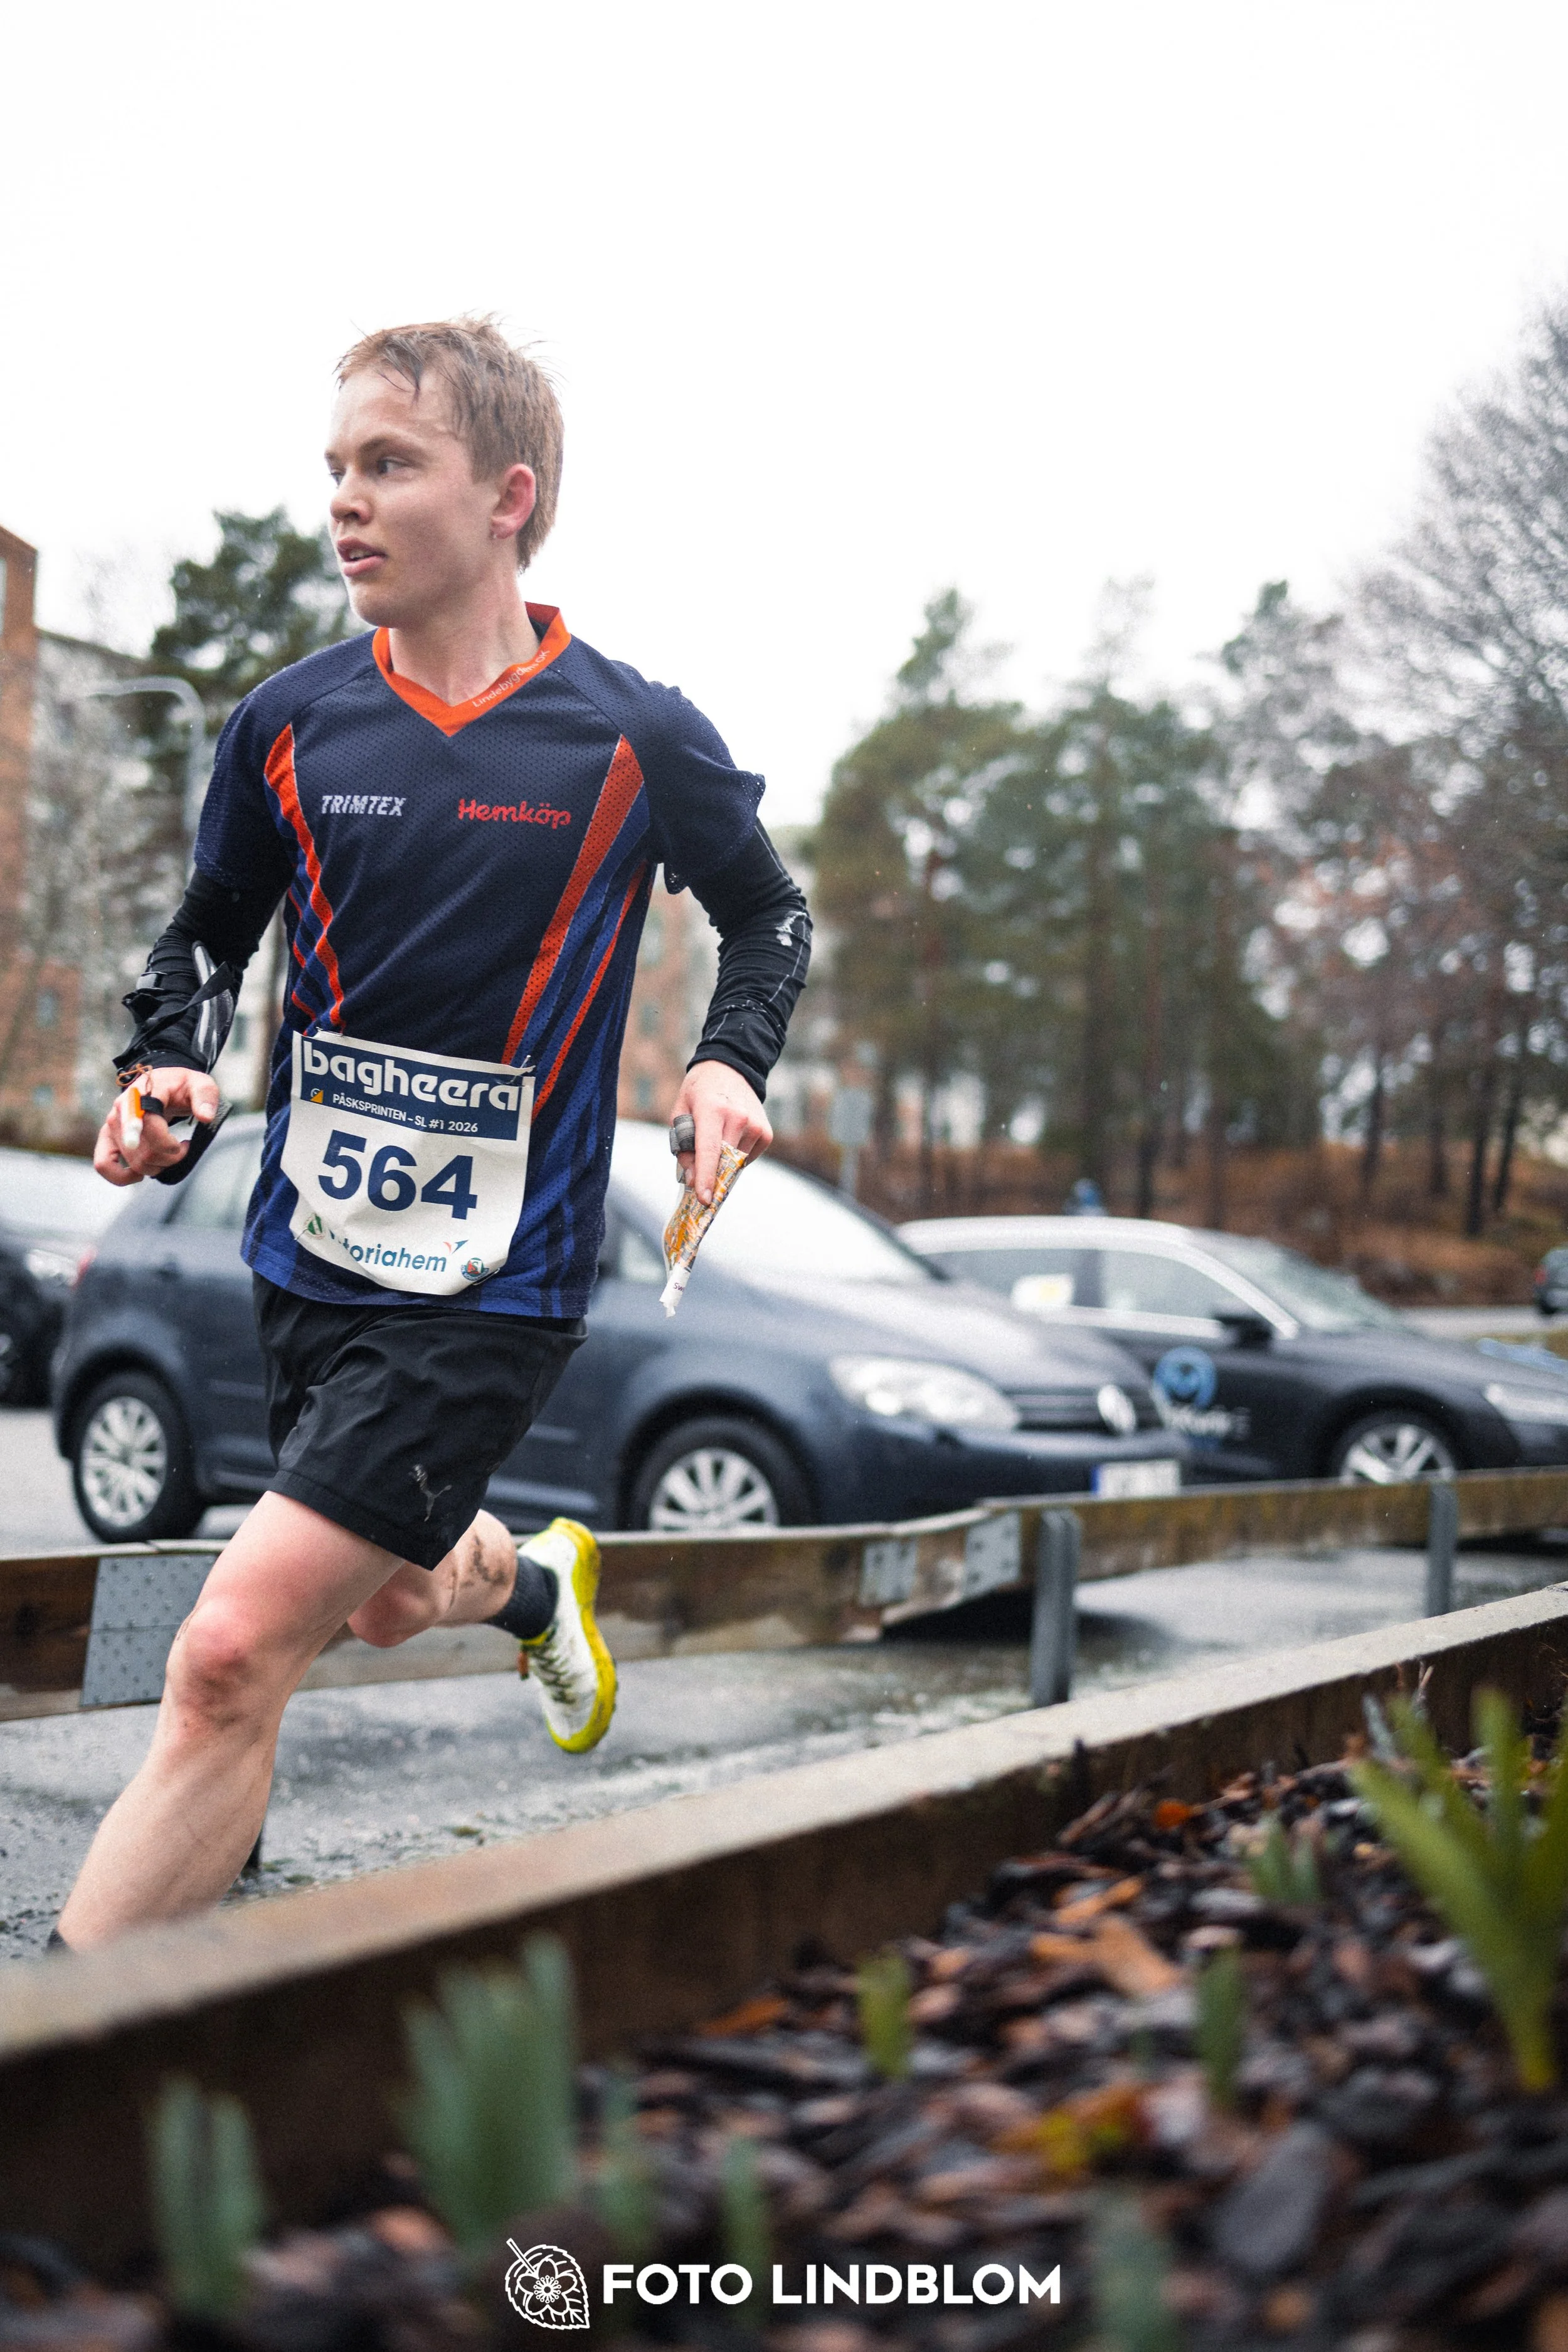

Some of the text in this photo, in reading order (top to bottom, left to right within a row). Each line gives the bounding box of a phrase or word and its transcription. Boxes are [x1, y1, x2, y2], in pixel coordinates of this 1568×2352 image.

[534, 650, 551, 663] OK
[321, 795, 406, 816] TRIMTEX
[458, 798, 571, 830] Hemköp
[304, 1041, 519, 1111] bagheera
[332, 1093, 406, 1121] PÅSKSPRINTEN
[414, 1115, 427, 1128] SL
[428, 1119, 444, 1130] #1
[448, 1121, 479, 1133] 2026
[318, 1129, 478, 1221] 564
